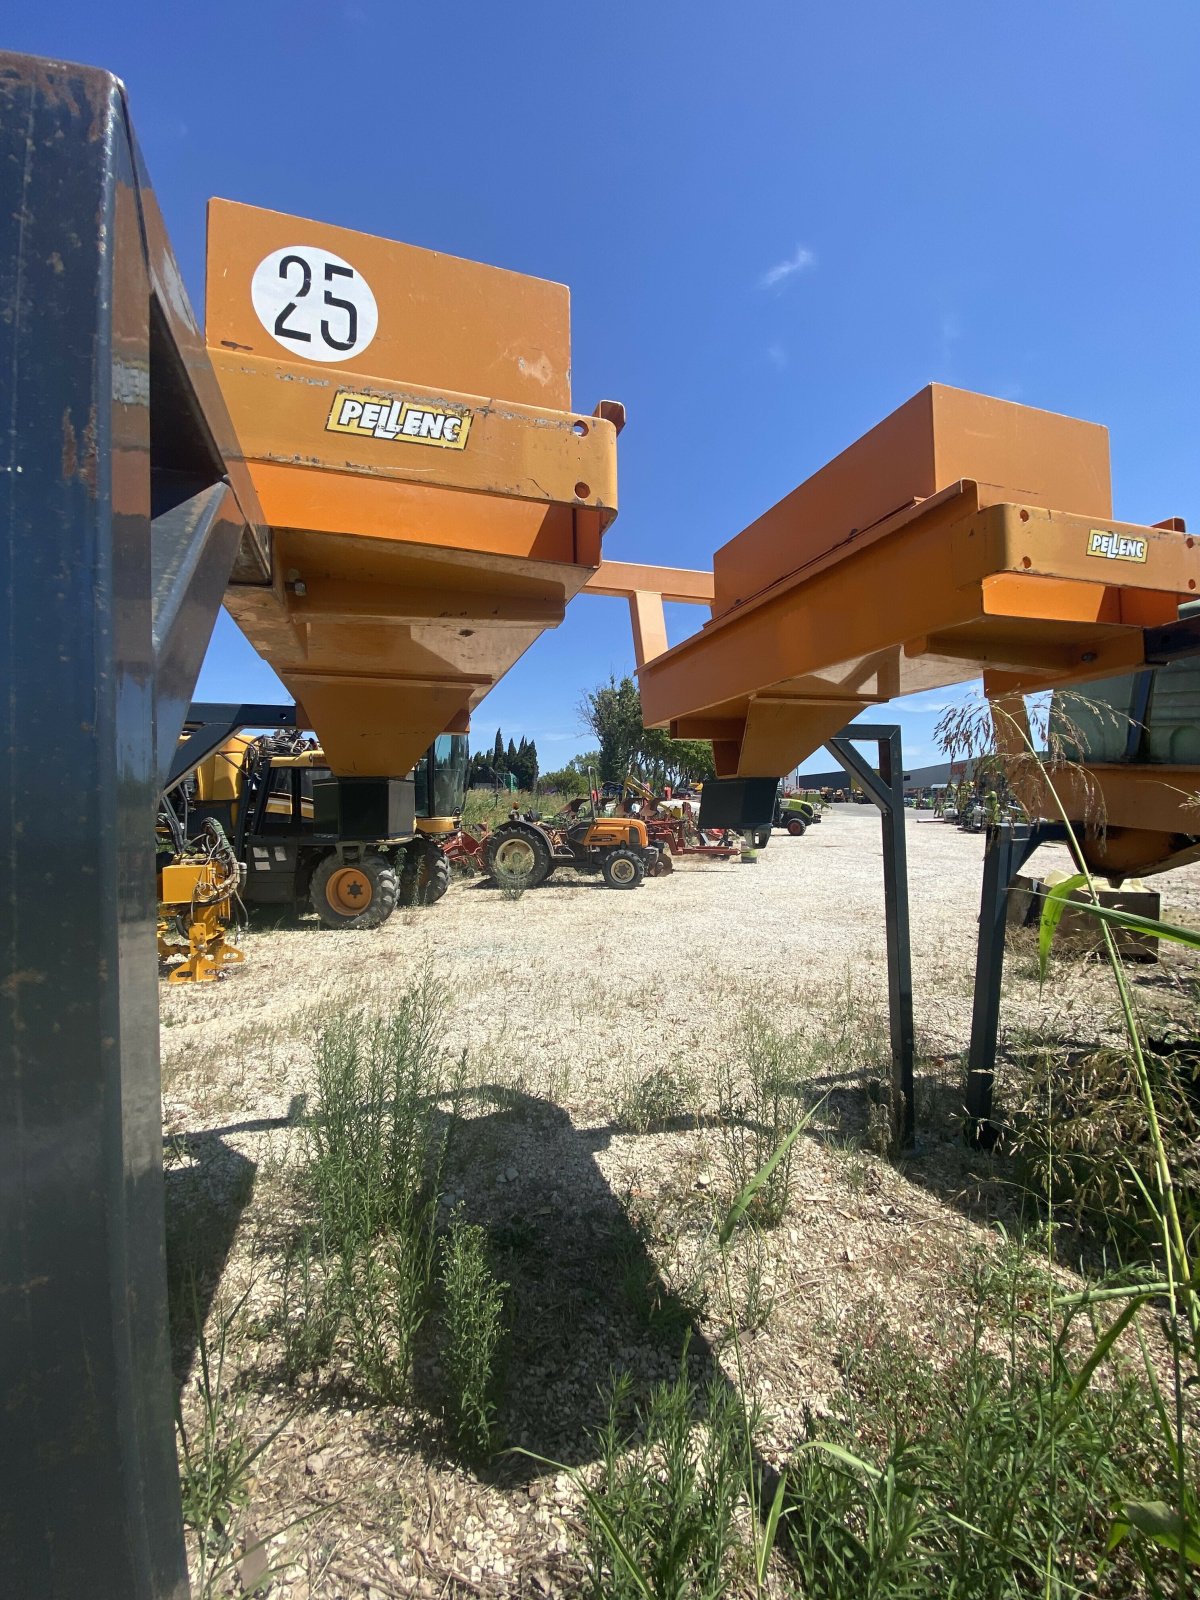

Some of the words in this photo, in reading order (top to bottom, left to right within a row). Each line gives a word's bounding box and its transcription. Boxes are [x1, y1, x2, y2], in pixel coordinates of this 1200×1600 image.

[275, 255, 358, 351] 25
[338, 400, 462, 442] PELLENC
[1091, 533, 1144, 558] PELLENC
